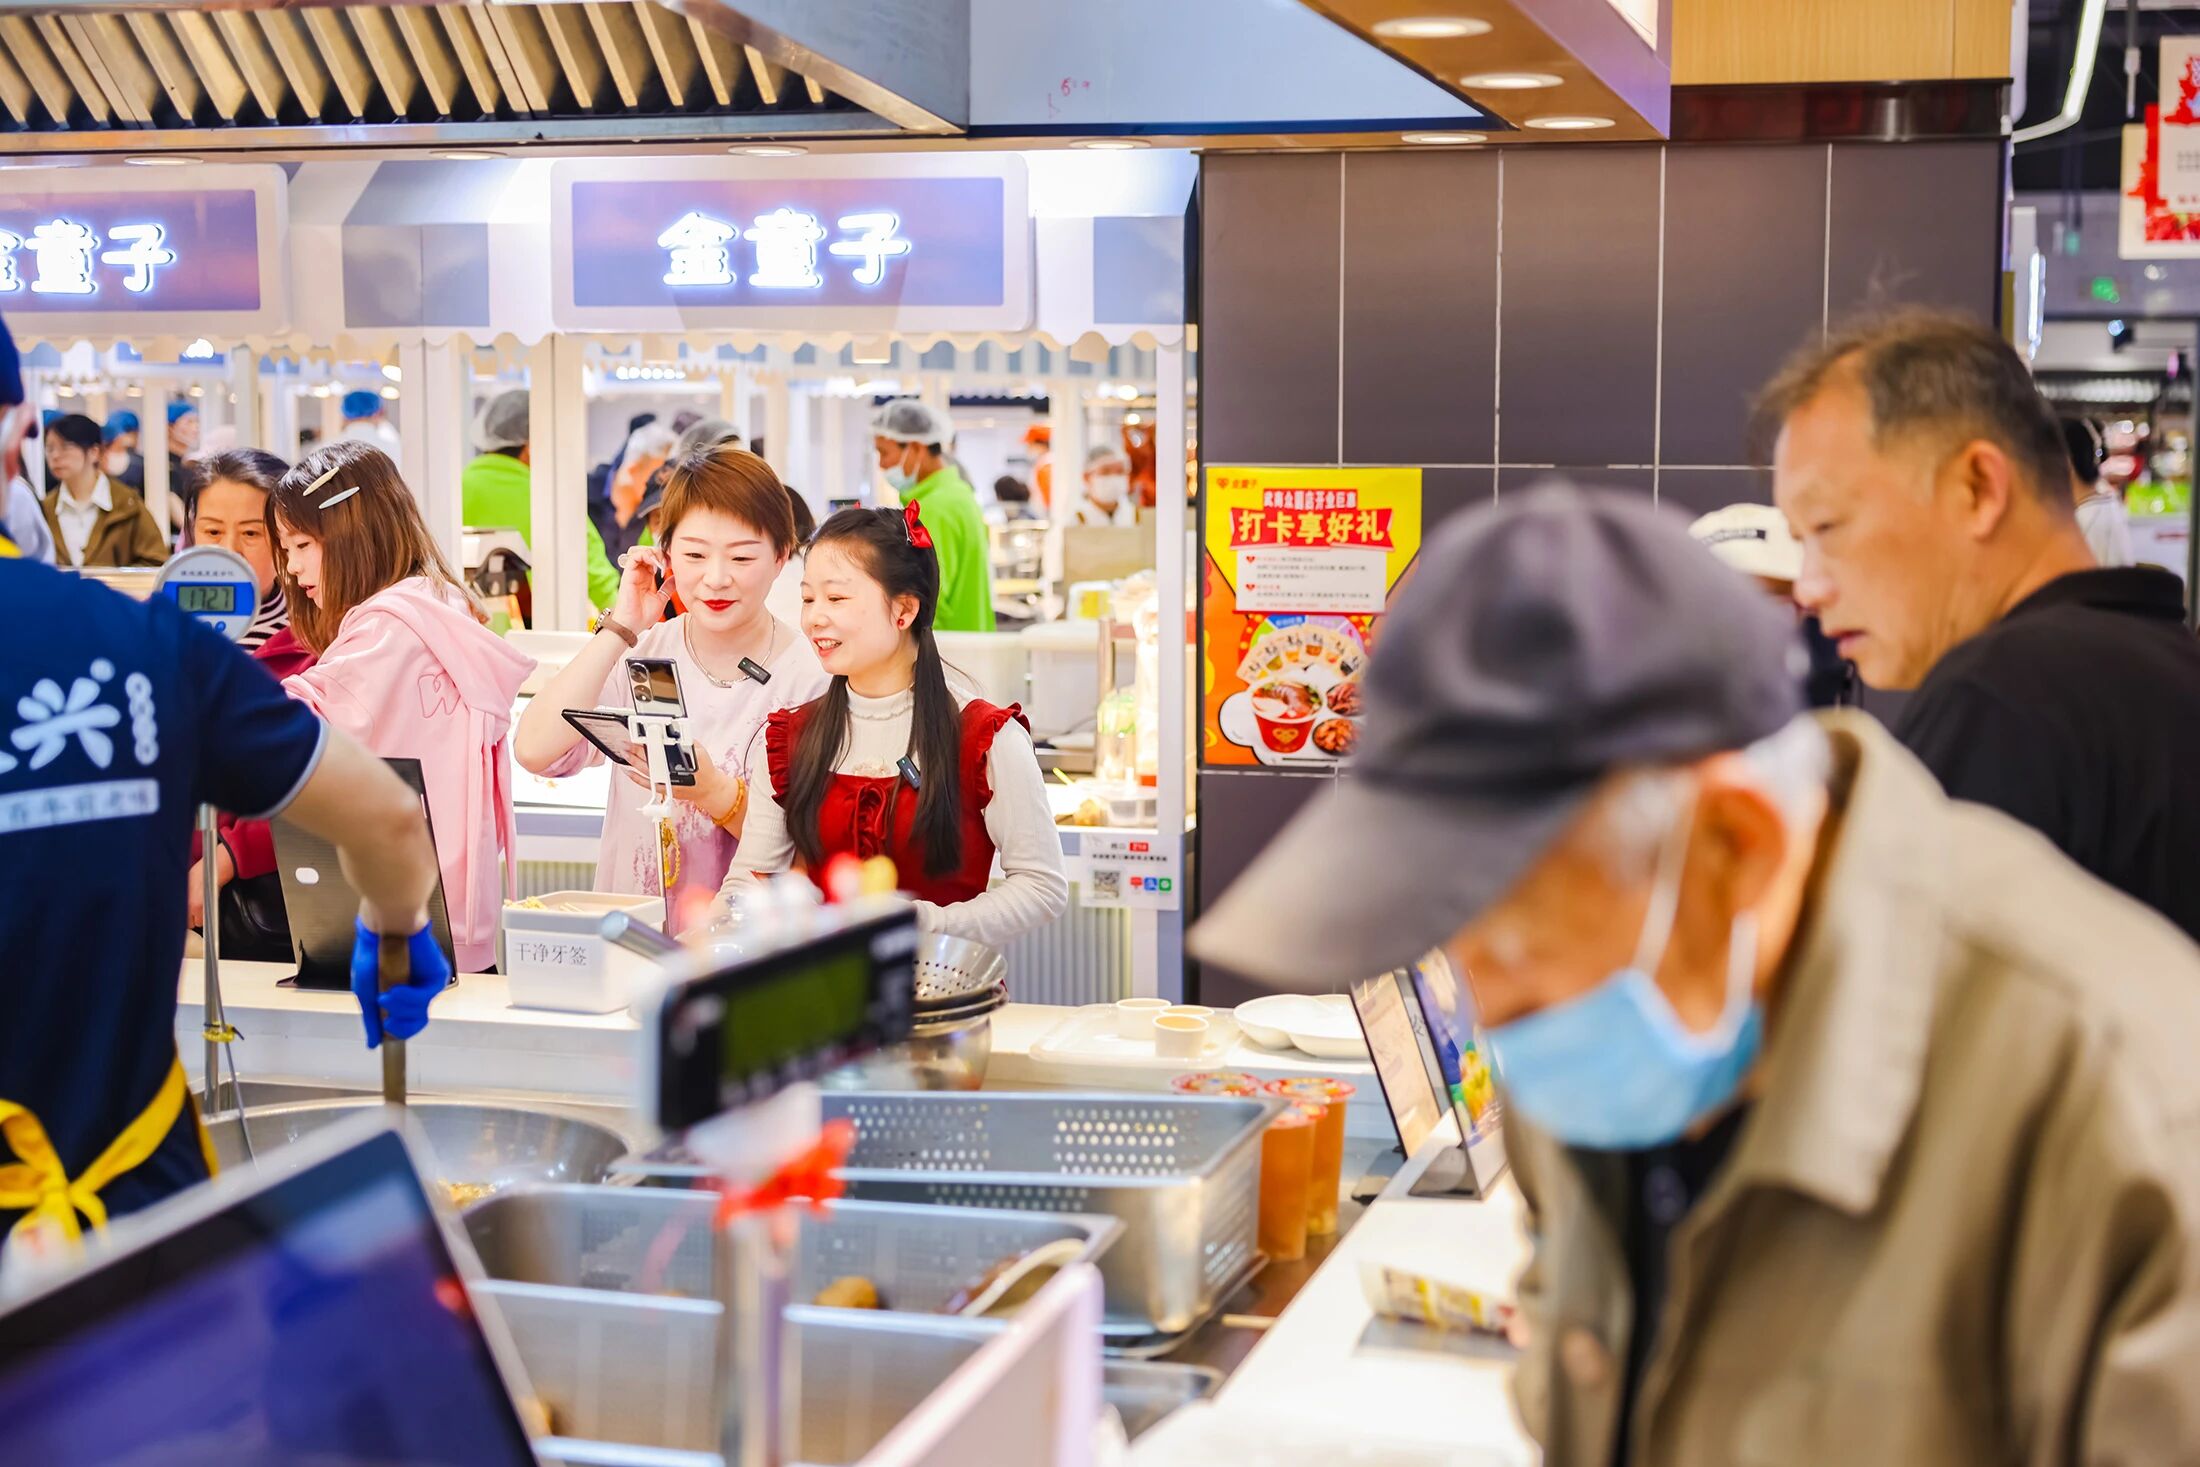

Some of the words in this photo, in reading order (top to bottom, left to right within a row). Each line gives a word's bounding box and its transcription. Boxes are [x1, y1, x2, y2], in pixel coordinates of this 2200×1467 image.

[1238, 510, 1385, 544] 打卡享好礼
[515, 942, 587, 966] 干净牙签
